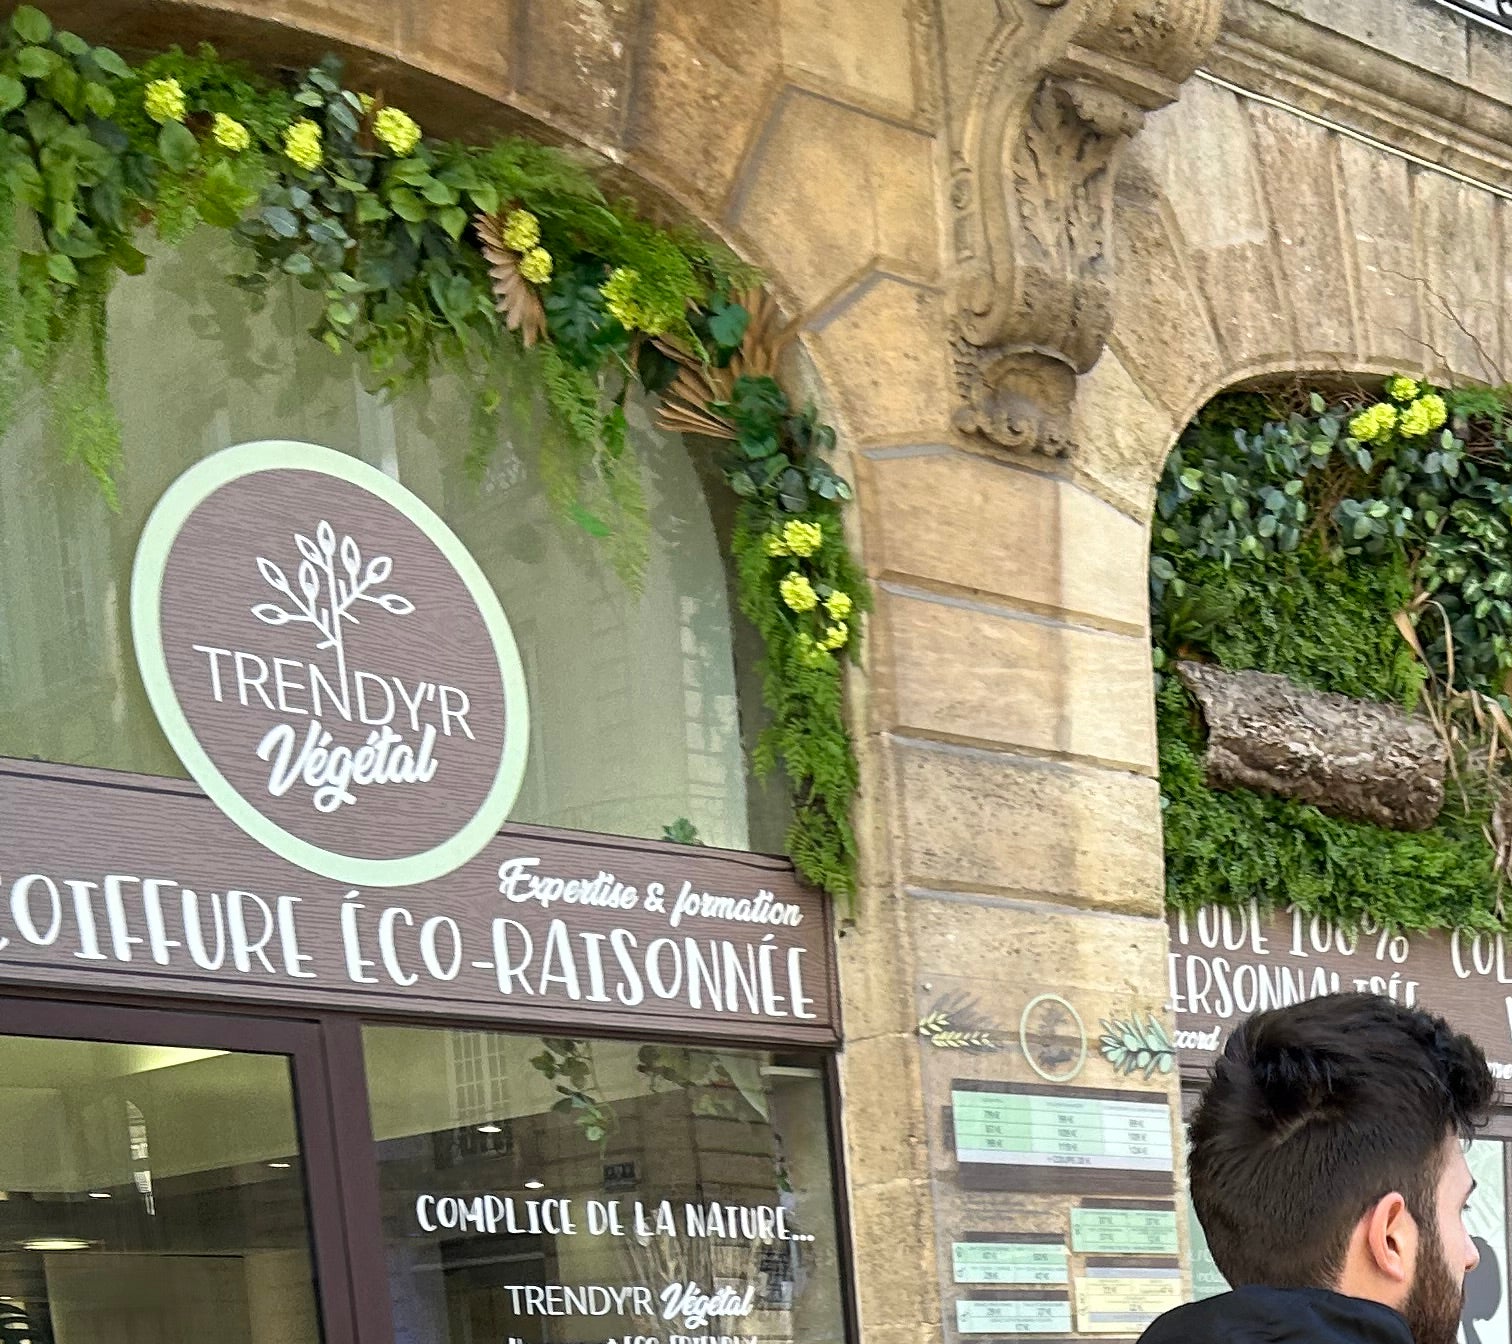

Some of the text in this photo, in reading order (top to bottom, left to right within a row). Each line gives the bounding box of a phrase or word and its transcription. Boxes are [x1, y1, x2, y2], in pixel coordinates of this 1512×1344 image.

[192, 643, 476, 742] TRENDY'R
[256, 720, 439, 814] Végétal
[498, 857, 804, 928] Expertise & formation
[0, 872, 818, 1020] OIFFURE ÉCO-RAISONNÉE
[415, 1193, 817, 1243] COMPLICE DE LA NATURE...
[503, 1280, 755, 1331] TRENDY'R Végétal
